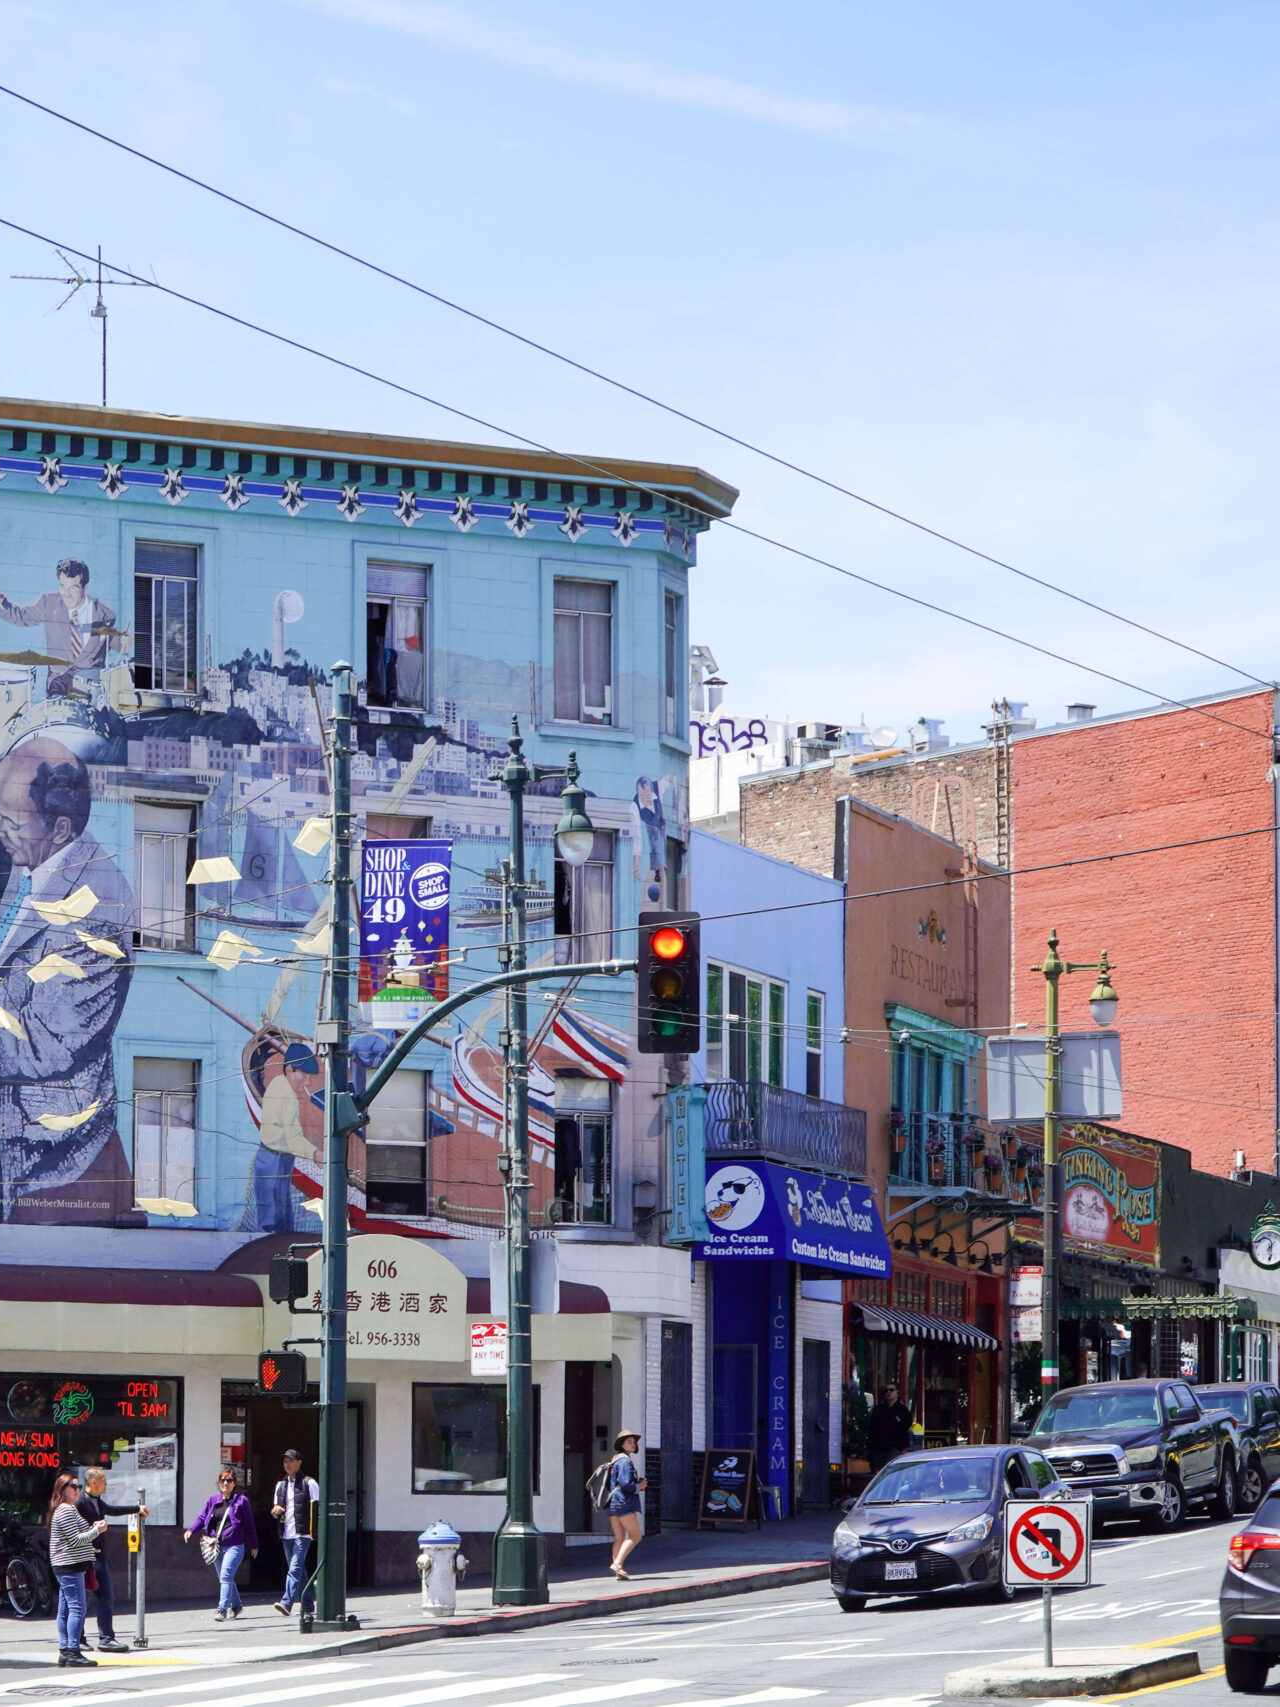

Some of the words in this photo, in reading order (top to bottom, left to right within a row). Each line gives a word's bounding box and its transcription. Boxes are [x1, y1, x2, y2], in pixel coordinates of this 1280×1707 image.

[365, 848, 406, 872] SHOP
[402, 861, 411, 870] &
[364, 872, 405, 897] DINE
[418, 875, 444, 890] SHOP
[418, 883, 449, 898] SMALL
[363, 897, 406, 924] 49
[675, 1096, 686, 1235] HOTEL
[1064, 1152, 1114, 1192] TINKING
[710, 1234, 727, 1243] Ice
[730, 1233, 769, 1243] Cream
[703, 1245, 775, 1256] Sandwiches
[792, 1238, 817, 1258] Custom
[818, 1243, 828, 1260] Ice
[828, 1246, 849, 1264] Cream
[849, 1250, 886, 1272] Sandwiches
[367, 1259, 398, 1279] 606
[774, 1296, 785, 1350] ICE
[367, 1331, 421, 1347] 956-3338
[472, 1338, 483, 1346] NO
[474, 1351, 487, 1360] ANY
[490, 1351, 505, 1360] TIME
[127, 1382, 158, 1398] OPEN
[69, 1410, 91, 1425] BEER
[141, 1402, 167, 1417] 3AM
[770, 1376, 786, 1469] CREAM
[0, 1431, 27, 1447] NEW
[31, 1432, 54, 1447] SUN
[28, 1452, 60, 1468] KONG
